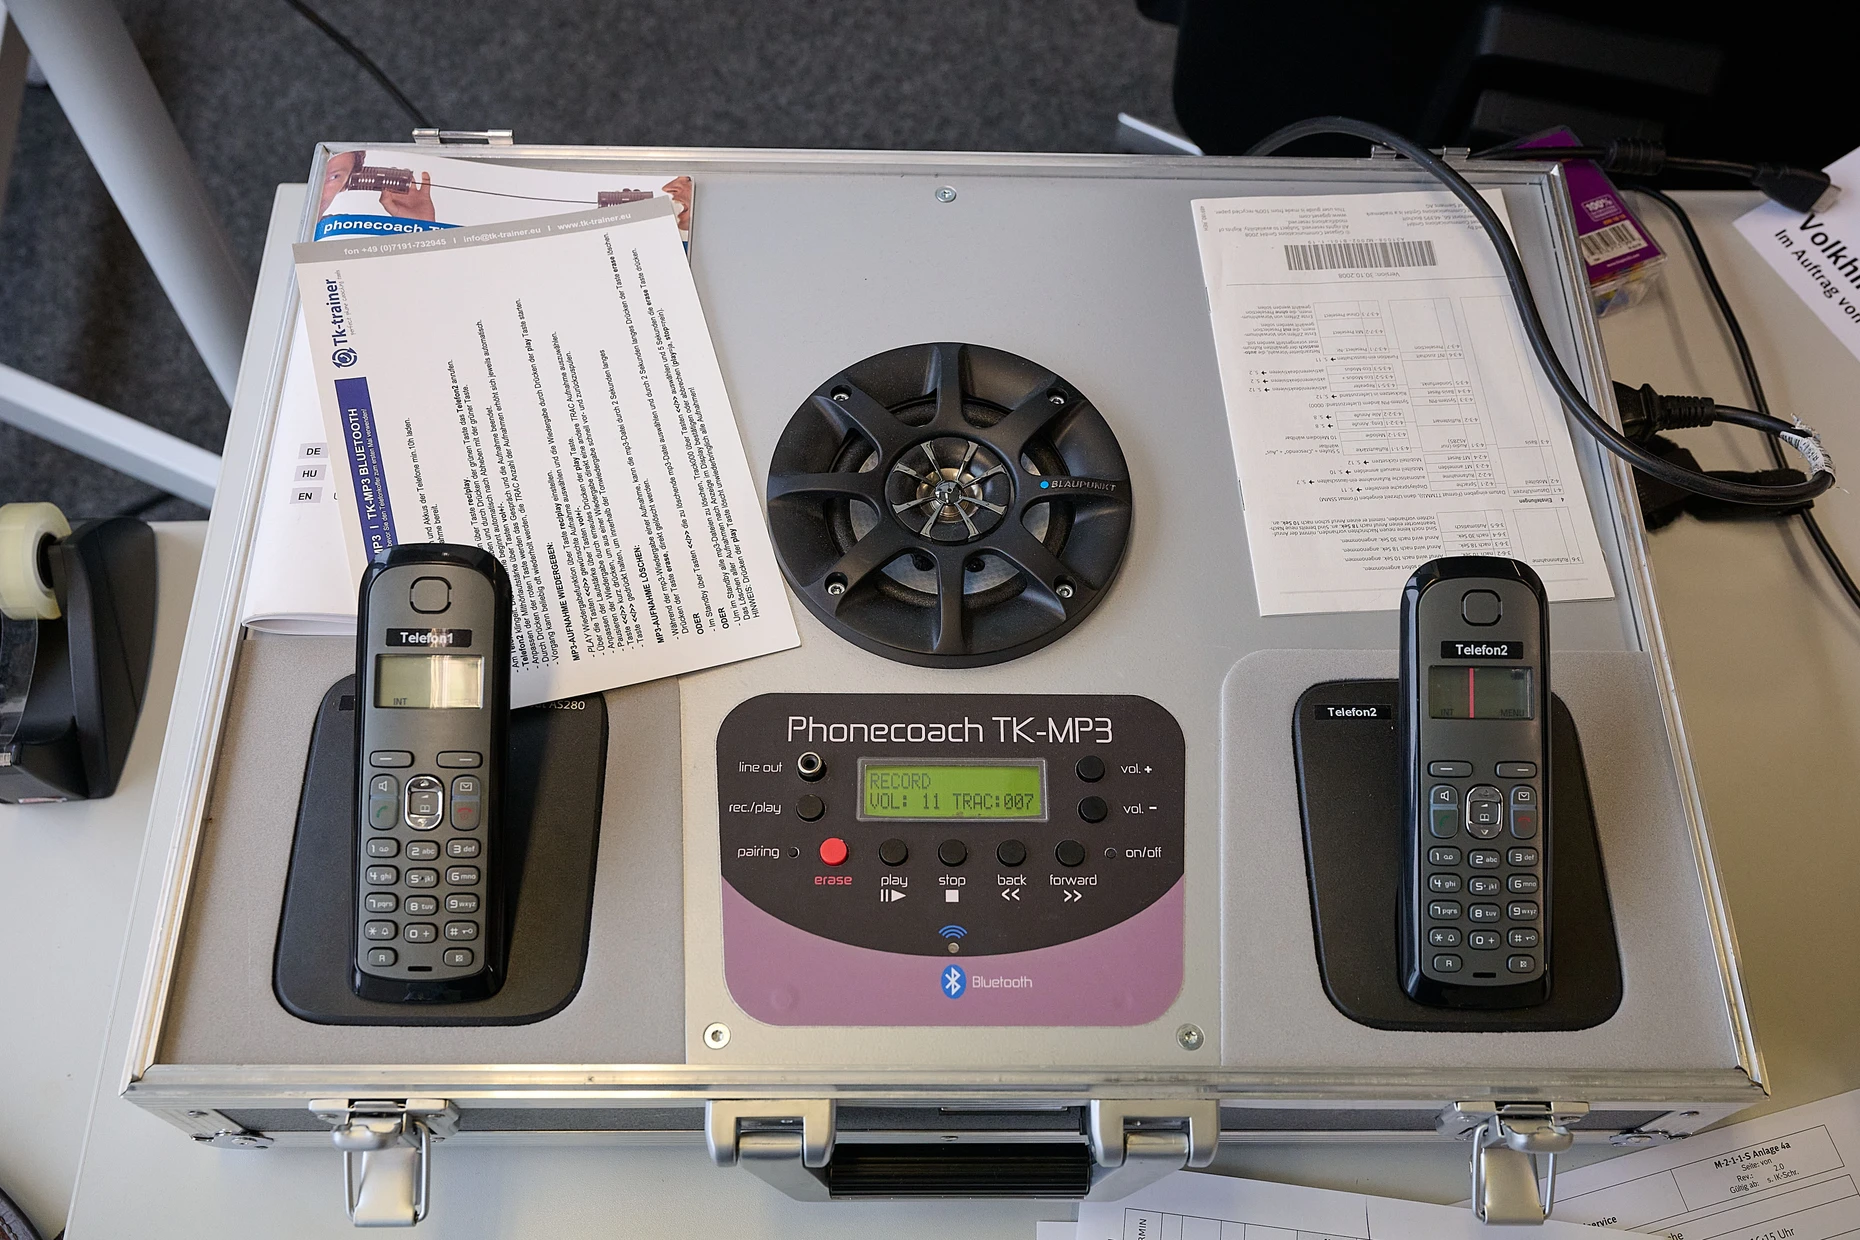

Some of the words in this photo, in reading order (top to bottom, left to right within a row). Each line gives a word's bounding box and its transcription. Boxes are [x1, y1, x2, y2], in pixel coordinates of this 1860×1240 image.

[322, 219, 424, 234] phonecoach
[344, 248, 360, 256] fon
[361, 246, 378, 254] +49
[464, 226, 542, 244] info@tk-trainer.eu
[556, 212, 632, 230] www.tk-trainer.eu
[1774, 229, 1794, 248] Im
[1791, 250, 1840, 299] Auftrag
[326, 279, 348, 346] Tk-trainer
[688, 387, 704, 422] Aufnahmen!
[361, 409, 371, 437] verwenden!
[405, 418, 413, 437] laden.
[348, 409, 369, 475] BLUETOOTH
[306, 448, 321, 456] DE
[407, 438, 418, 463] min.10h
[702, 436, 722, 488] unwiederbringlich
[302, 470, 318, 478] HU
[414, 464, 424, 492] Telefone
[644, 478, 654, 503] werden.
[1051, 479, 1117, 492] BLAUPUNKT
[298, 492, 312, 500] EN
[361, 478, 377, 520] TK-MP3
[375, 477, 385, 510] Telefonkoffer
[718, 489, 728, 508] löscht
[422, 505, 431, 525] Akkus
[649, 504, 663, 531] gelöscht
[724, 509, 733, 527] Taste
[425, 527, 434, 539] und
[730, 529, 740, 542] play
[656, 532, 666, 550] direkt
[634, 545, 648, 582] LÖSCHEN:
[663, 551, 672, 572] erase,
[547, 542, 565, 600] WIEDERGEBEN:
[738, 556, 750, 583] Drücken
[668, 574, 677, 592] Taste
[745, 584, 760, 618] HINWEIS:
[643, 584, 664, 643] MP3-AUFNAHME
[677, 606, 689, 634] Drücken
[718, 607, 729, 629] ODER
[560, 600, 580, 661] MP3-AUFNAHME
[693, 613, 704, 634] ODER
[400, 632, 454, 644] Telefon1
[1455, 644, 1508, 656] Telefon2
[548, 700, 586, 710] AS280
[1327, 707, 1378, 718] Telefon2
[786, 716, 984, 744] Phonecoach
[992, 716, 1114, 744] TK-MP3
[738, 761, 760, 773] line
[762, 761, 783, 773] out
[1120, 763, 1142, 775] vol.
[869, 773, 932, 790] RECORD
[728, 801, 782, 815] rec./play
[869, 793, 909, 811] VOL:
[922, 793, 941, 810] 11
[953, 793, 1035, 811] TRAC:007
[1123, 803, 1145, 814] vol.
[371, 845, 376, 853] 1
[412, 848, 420, 856] 2
[453, 845, 462, 853] 3
[737, 845, 780, 860] pairing
[1124, 846, 1162, 860] on/off
[1435, 852, 1440, 861] 1
[1476, 856, 1484, 864] 2
[1515, 854, 1522, 862] 3
[370, 872, 378, 880] 4
[410, 875, 419, 883] 5
[452, 872, 460, 880] 6
[814, 874, 852, 886] erase
[880, 873, 908, 889] play
[938, 874, 966, 889] stop
[997, 873, 1027, 887] back
[1049, 873, 1098, 887] forward
[1434, 880, 1442, 888] 4
[1476, 882, 1483, 890] 5
[1514, 880, 1522, 888] 6
[370, 900, 376, 908] 7
[410, 902, 418, 911] 8
[450, 900, 458, 908] 9
[1434, 906, 1441, 914] 7
[1513, 906, 1520, 915] 9
[1475, 909, 1482, 918] 8
[410, 930, 418, 938] 0
[1476, 936, 1483, 944] 0
[972, 975, 1033, 989] Bluetooth
[1714, 1153, 1751, 1170] M-2-1-1-S
[1752, 1146, 1780, 1158] Anlage
[1780, 1141, 1791, 1150] 4a
[1742, 1162, 1760, 1172] Seite:
[1760, 1158, 1772, 1166] von
[1736, 1173, 1754, 1182] Rev.:
[1774, 1163, 1785, 1172] 2.0
[1730, 1184, 1749, 1194] Gültig
[1750, 1180, 1760, 1189] ab:
[1774, 1169, 1800, 1180] IK-Schr.
[1777, 1228, 1794, 1238] Uhr
